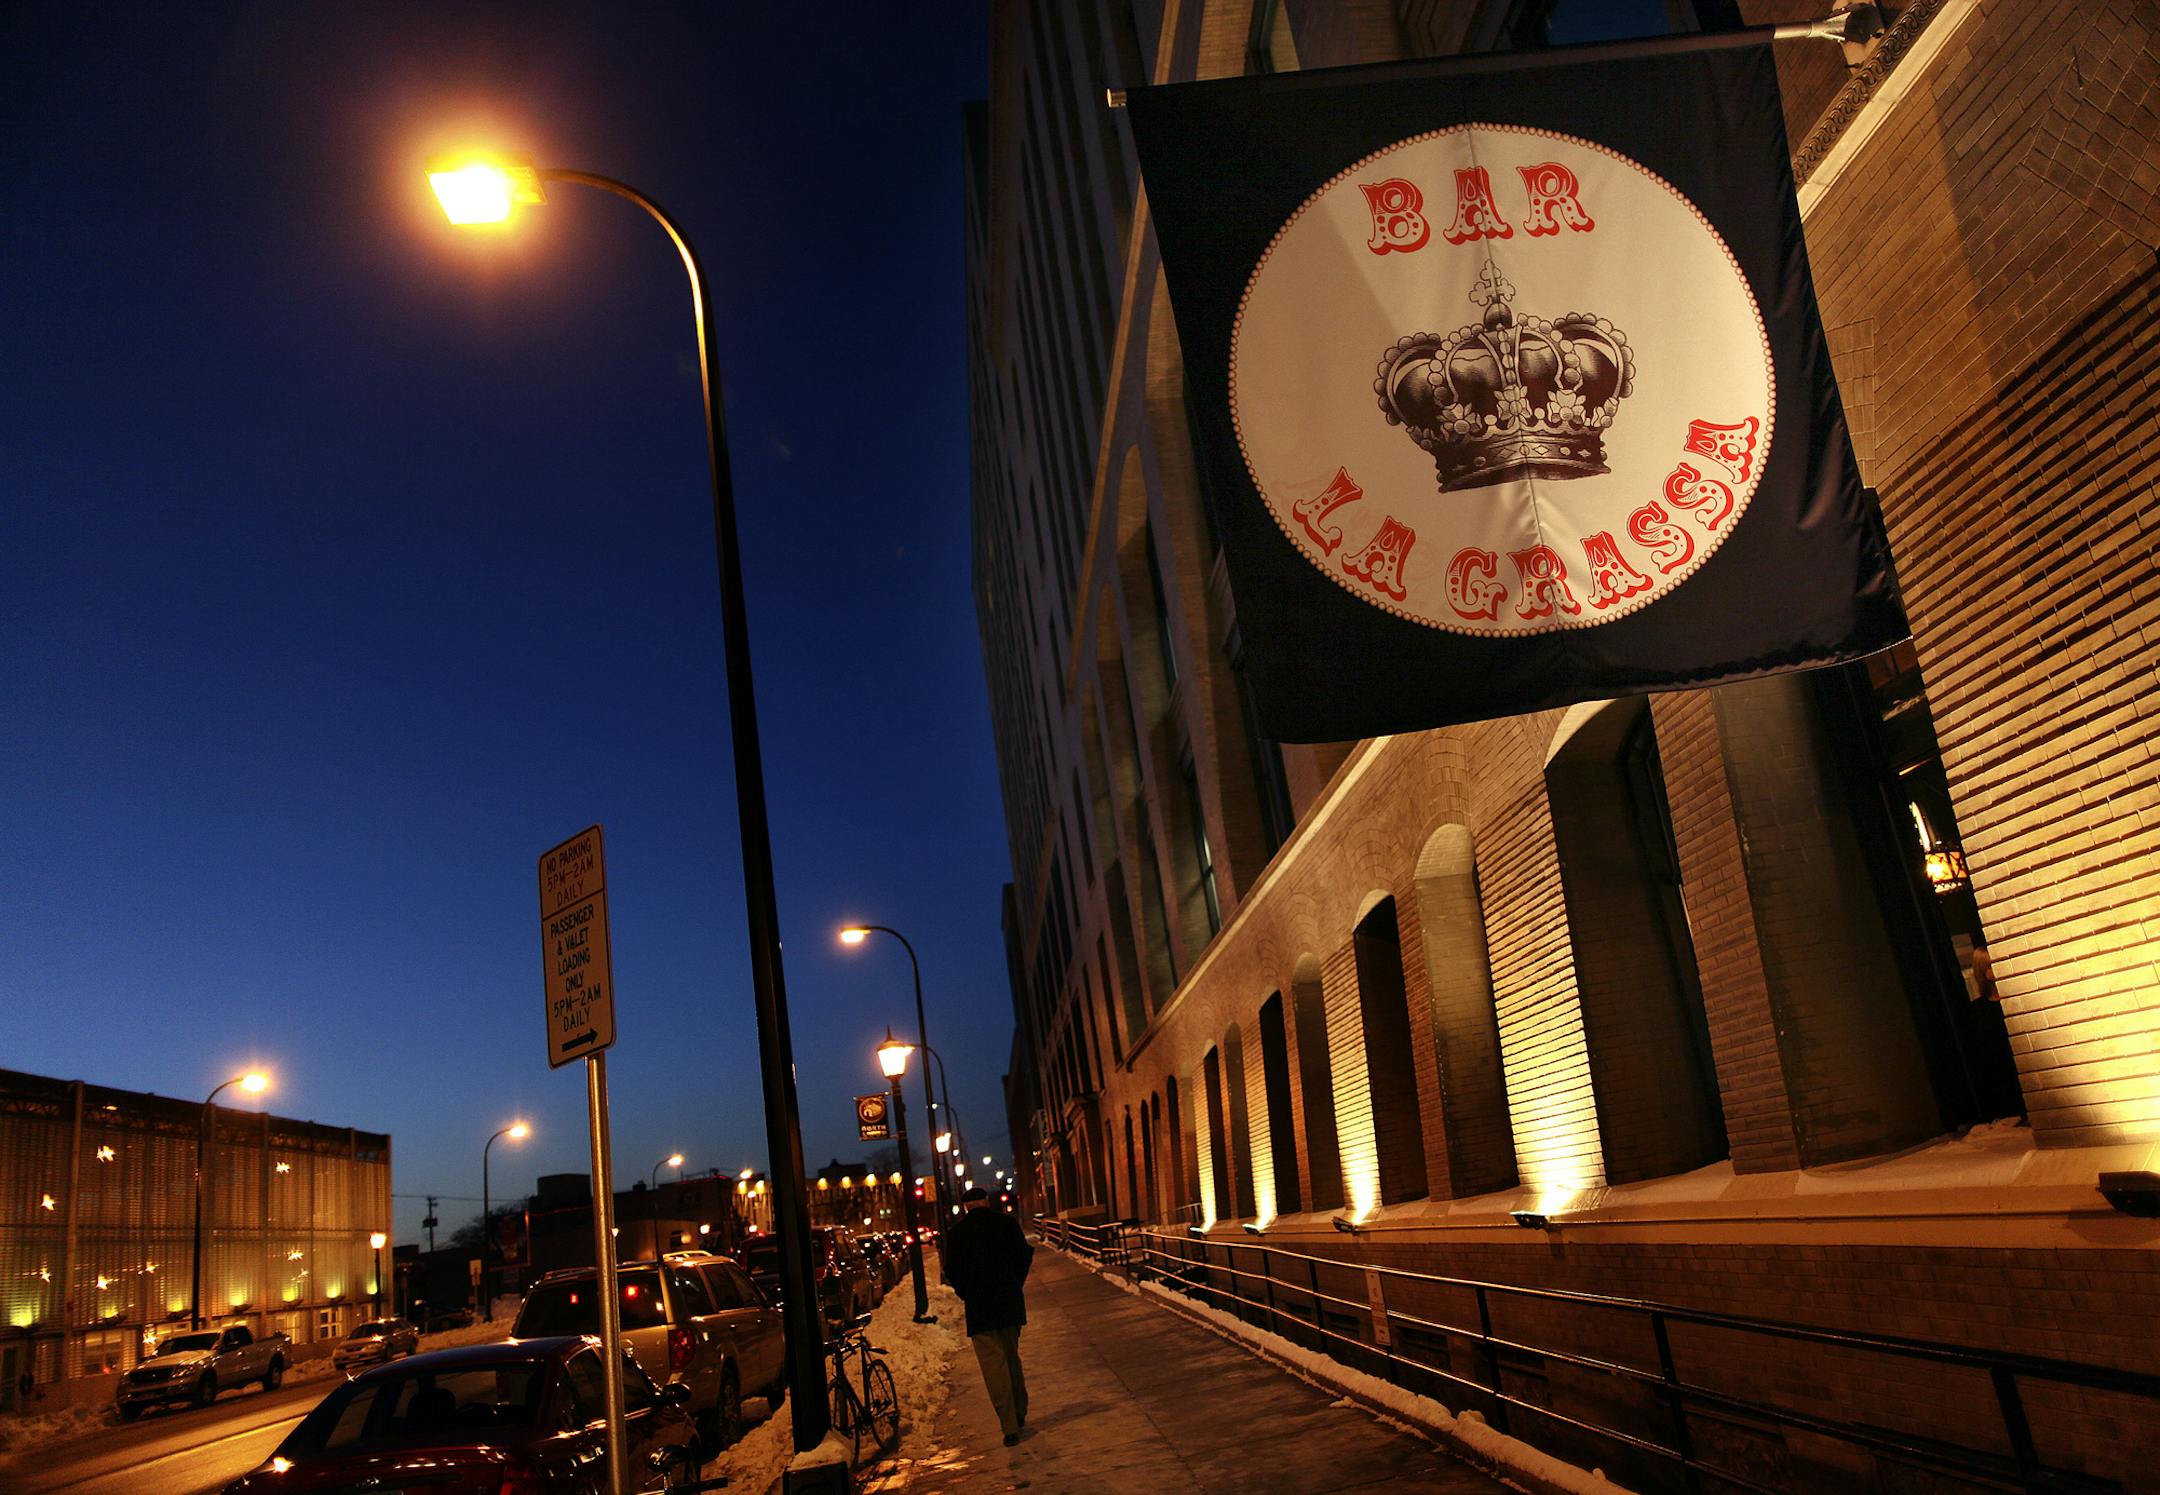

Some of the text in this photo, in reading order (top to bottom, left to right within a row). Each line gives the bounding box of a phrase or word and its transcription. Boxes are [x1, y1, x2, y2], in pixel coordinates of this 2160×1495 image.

[1358, 161, 1595, 256] BAR
[1292, 416, 1760, 620] LA GRASSA
[547, 838, 591, 874] NO PARKING
[557, 879, 584, 907] DAILY
[551, 904, 594, 939] PASSENGER
[557, 927, 588, 955] & VALET
[558, 948, 591, 976] LOADING
[566, 971, 584, 993] ONLY
[563, 1008, 591, 1032] DAILY
